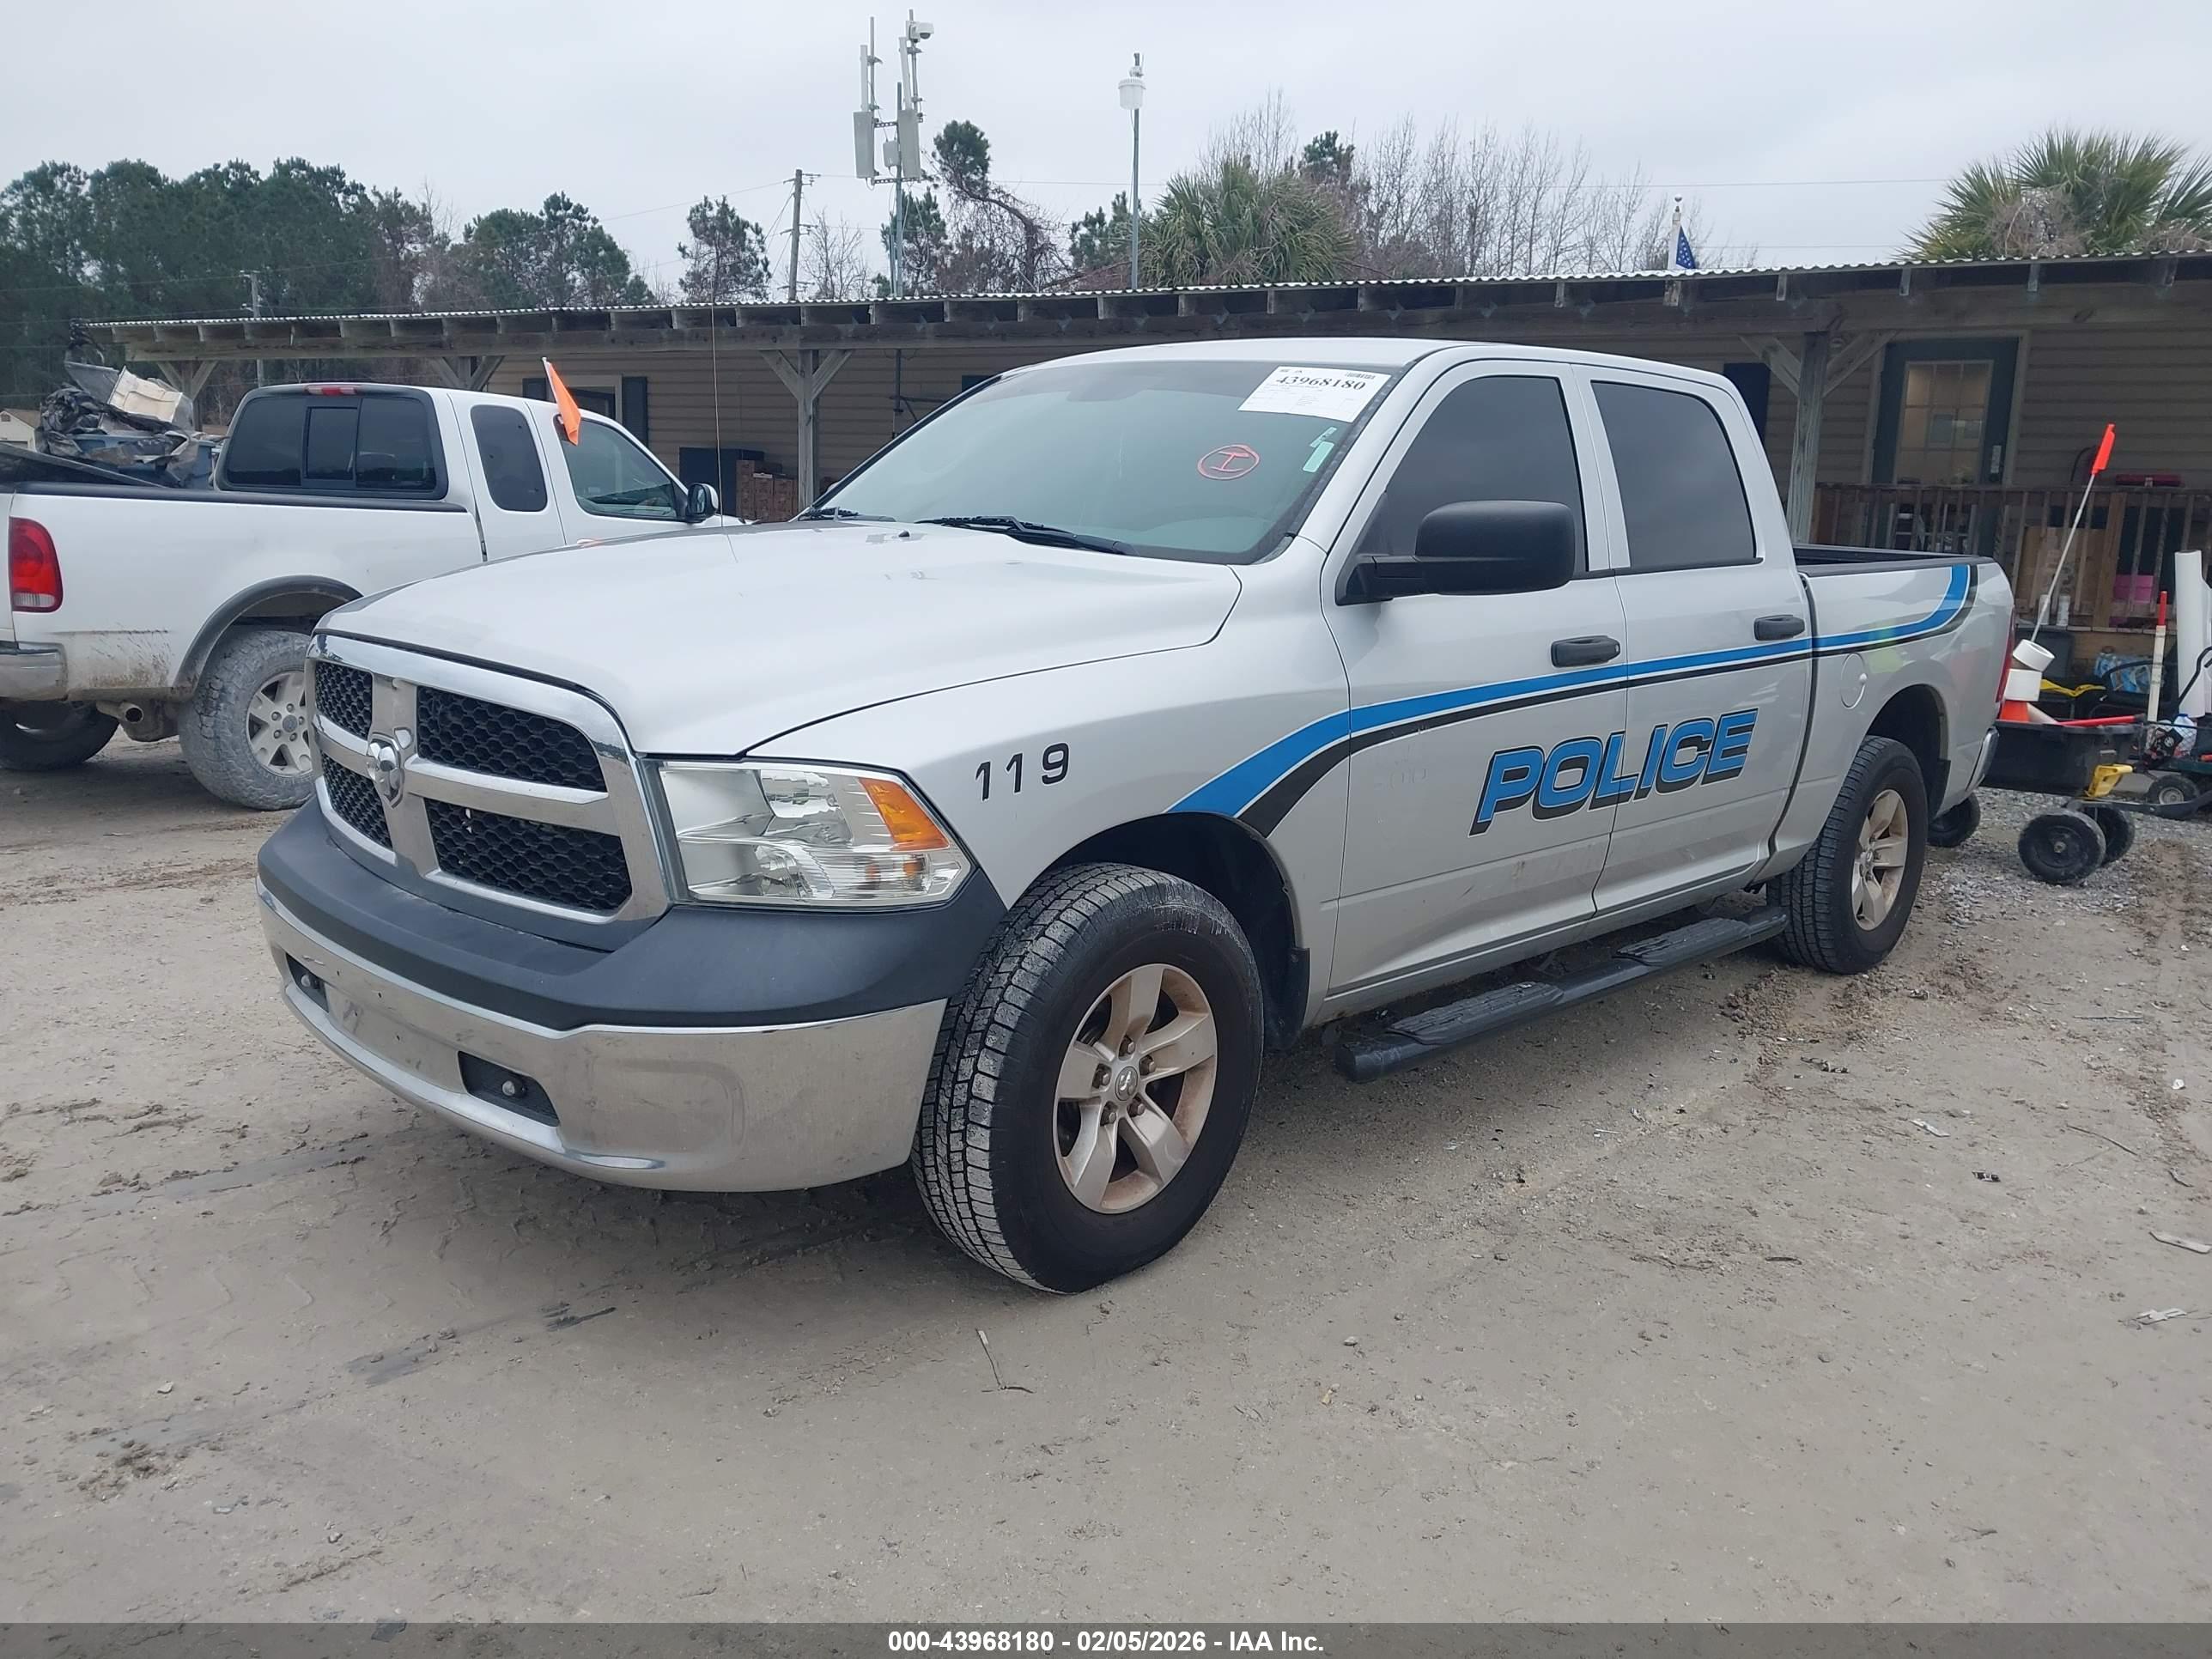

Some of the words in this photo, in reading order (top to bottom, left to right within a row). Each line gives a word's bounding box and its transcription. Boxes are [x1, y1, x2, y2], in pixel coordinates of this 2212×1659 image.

[1276, 375, 1366, 391] 43968180
[975, 742, 1070, 802] 119
[1468, 708, 1759, 837] POLICE
